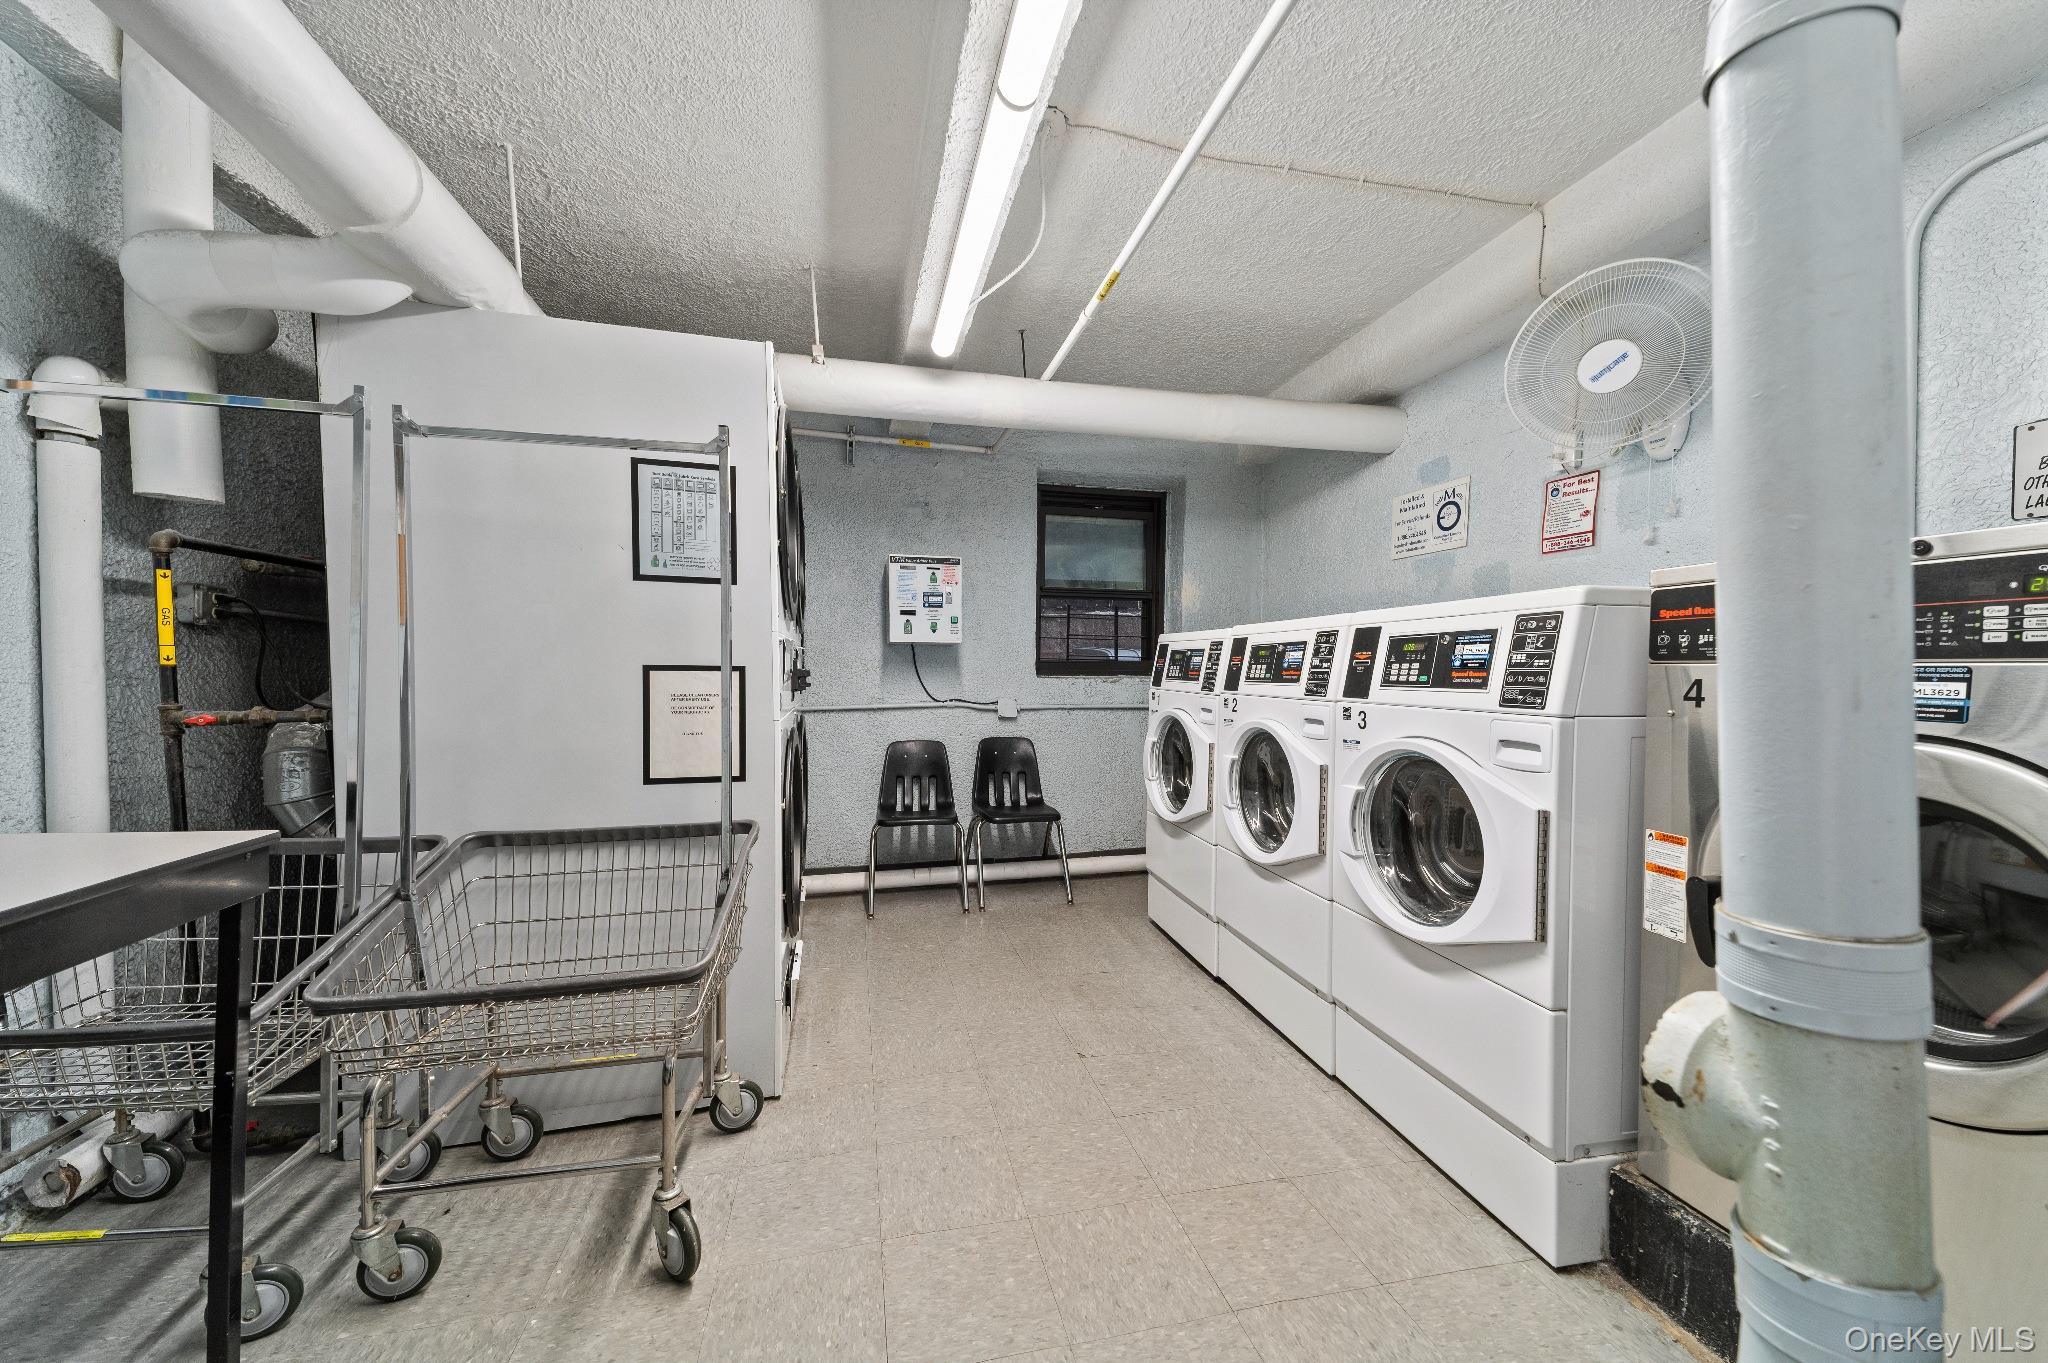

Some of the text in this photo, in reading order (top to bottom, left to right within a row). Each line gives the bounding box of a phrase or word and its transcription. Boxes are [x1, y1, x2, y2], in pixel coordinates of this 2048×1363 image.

[1562, 481, 1576, 489] For
[1577, 477, 1595, 485] Best
[162, 607, 171, 626] GAS
[1659, 607, 1693, 619] Speed
[1683, 678, 1706, 709] 4
[1231, 697, 1238, 713] 2
[1357, 710, 1367, 730] 3
